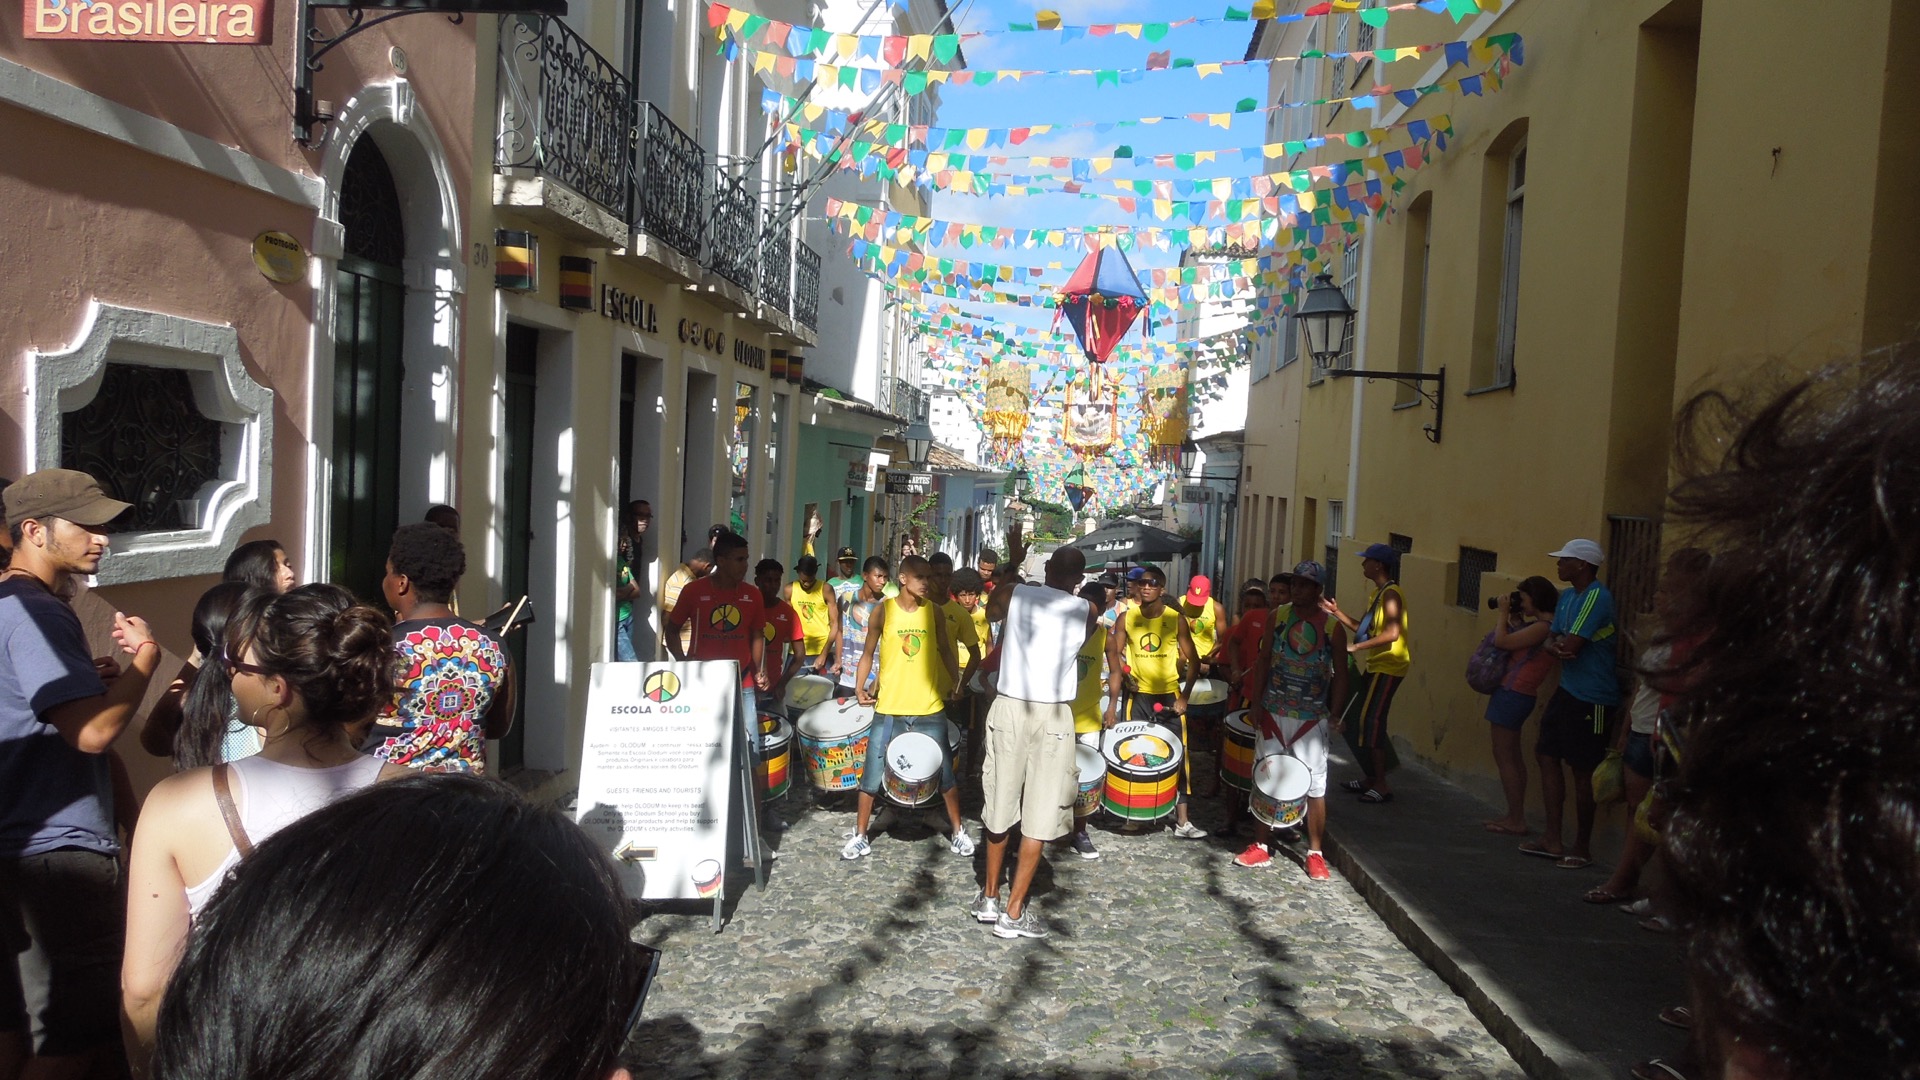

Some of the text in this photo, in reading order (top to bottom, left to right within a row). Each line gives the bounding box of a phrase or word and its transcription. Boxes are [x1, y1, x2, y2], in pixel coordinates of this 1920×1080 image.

[36, 0, 255, 37] Brasileira
[264, 236, 298, 252] PROTEGIDO
[473, 242, 488, 268] 30
[601, 283, 766, 370] ESCOLA OLODUM
[912, 476, 930, 484] ARTES
[610, 705, 706, 714] ESCOLA OLOD
[1115, 724, 1148, 734] GOPE
